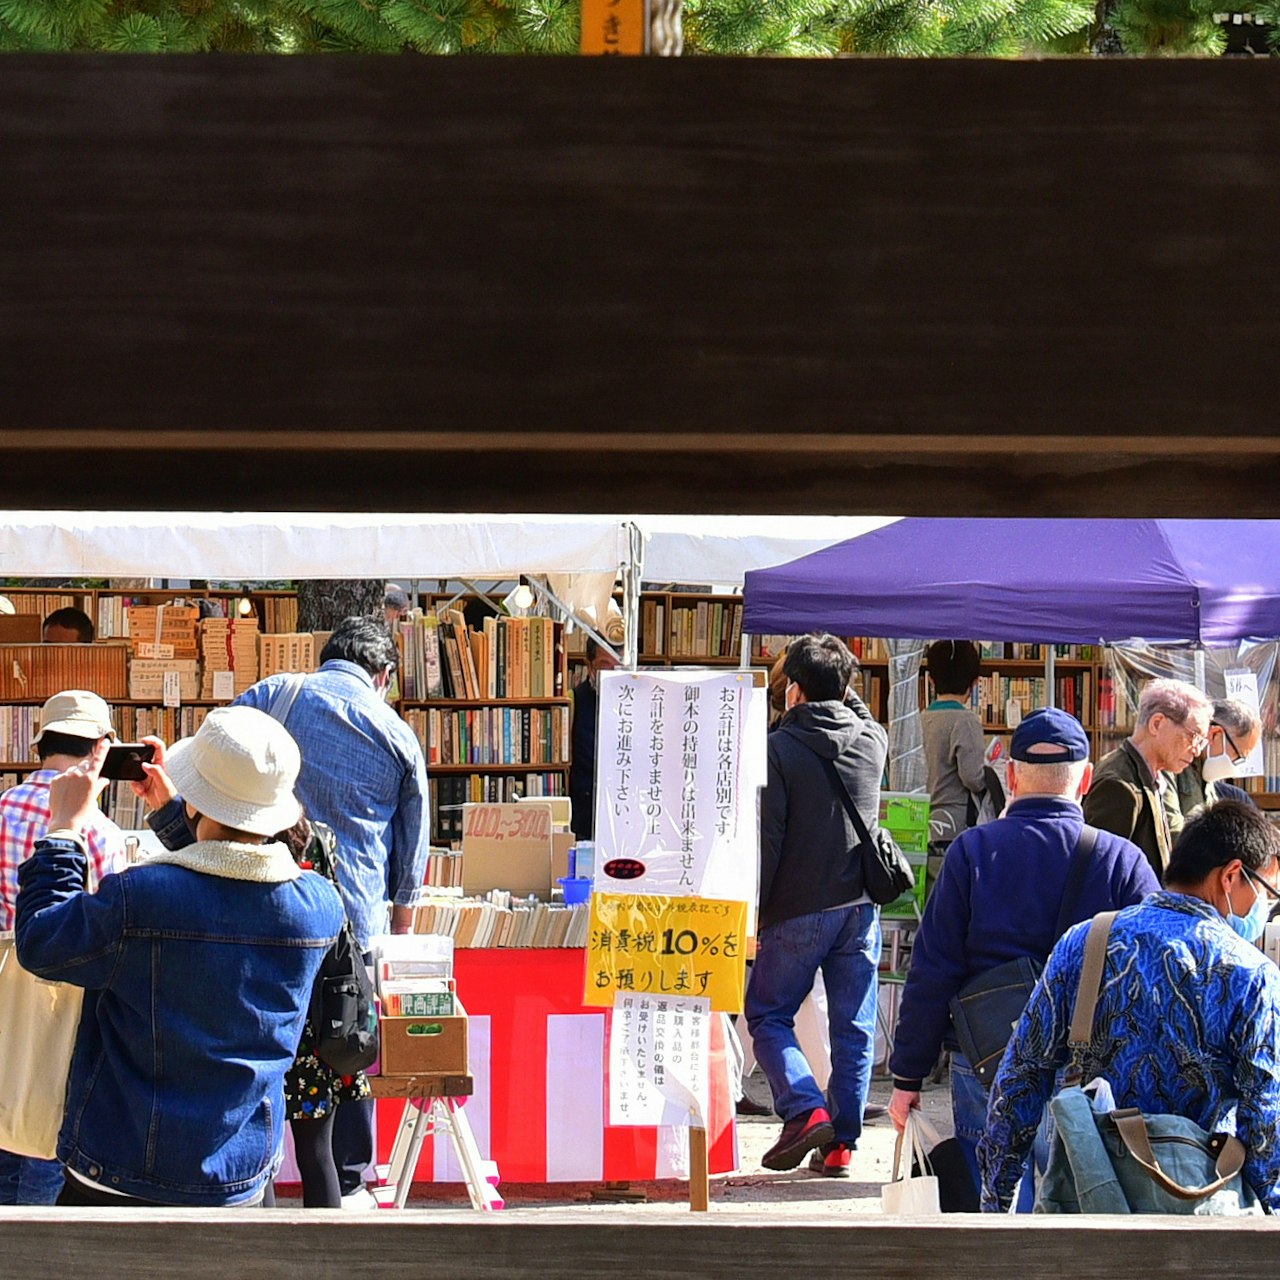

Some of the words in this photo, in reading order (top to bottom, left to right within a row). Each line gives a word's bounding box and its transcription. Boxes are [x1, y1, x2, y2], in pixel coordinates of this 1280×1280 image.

[596, 968, 713, 996] お預りします
